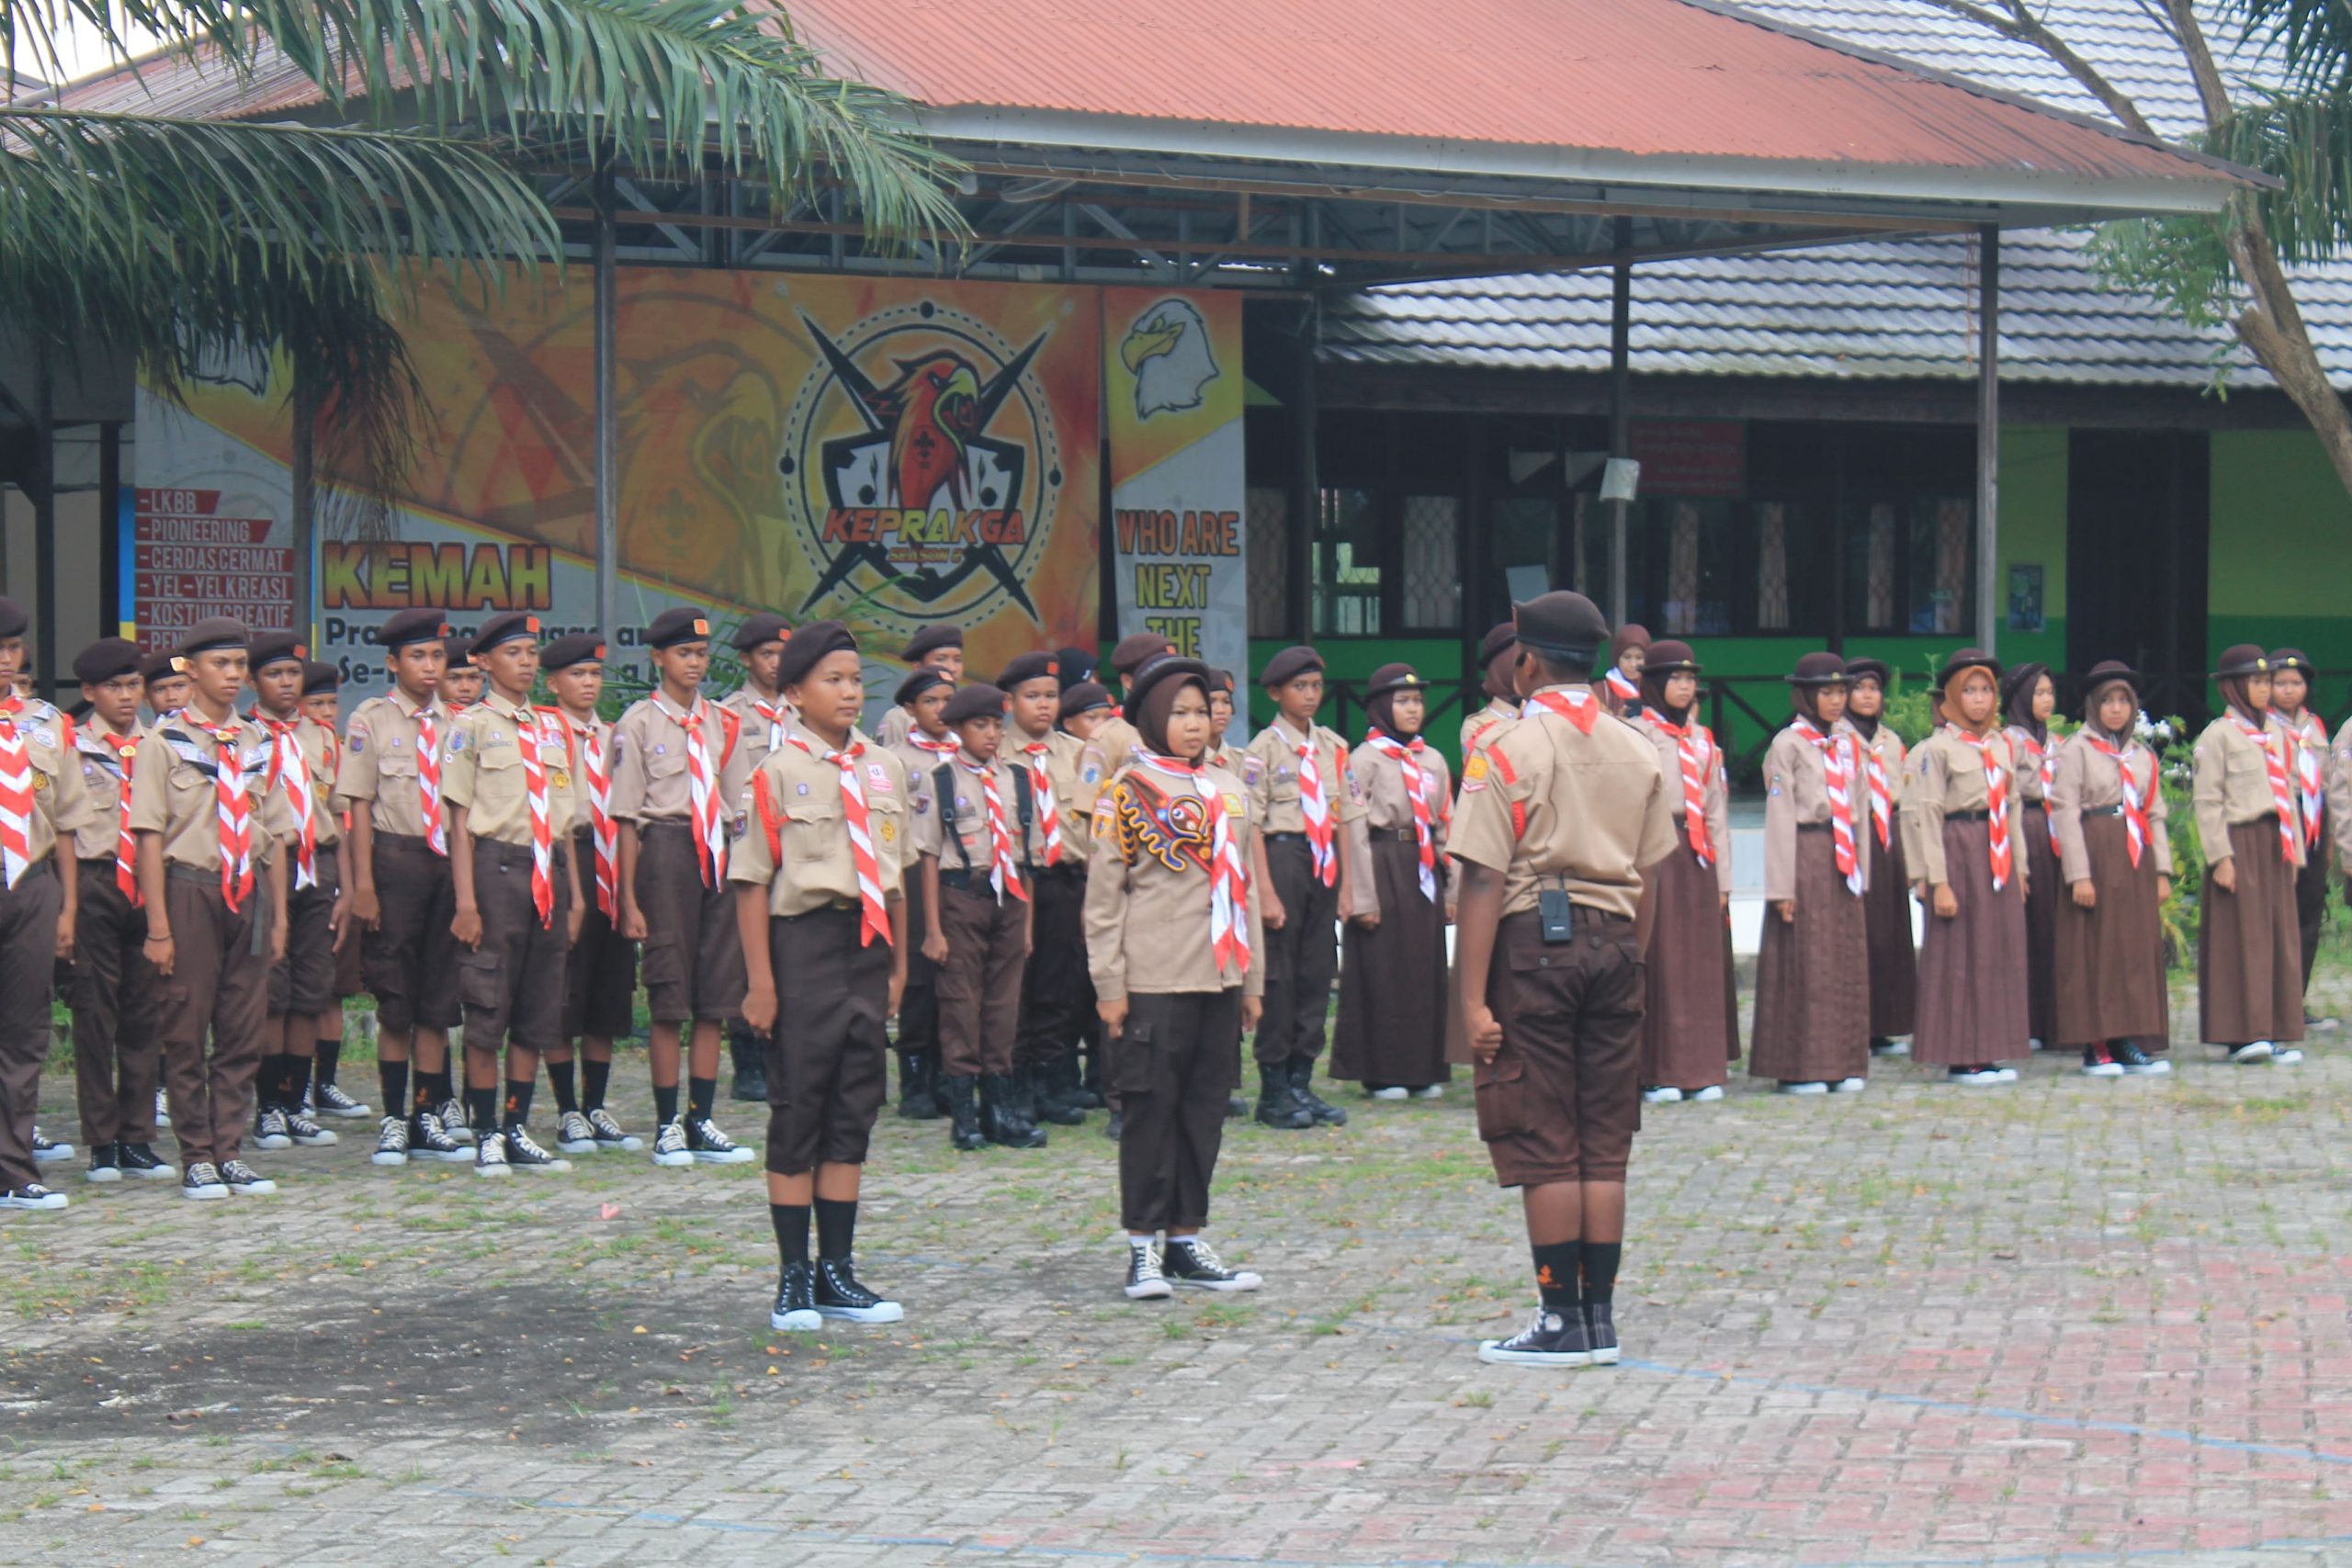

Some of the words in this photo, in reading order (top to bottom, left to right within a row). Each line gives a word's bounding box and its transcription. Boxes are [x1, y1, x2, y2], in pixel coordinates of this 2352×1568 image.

[821, 507, 1025, 544] KEPRAKGA
[1114, 509, 1178, 556] WHO
[1180, 510, 1240, 557] ARE
[219, 548, 286, 572] CERMAT
[322, 540, 551, 611] KEMAH
[226, 576, 287, 600] KREASI
[1136, 562, 1212, 610] NEXT
[1146, 616, 1202, 660] THE
